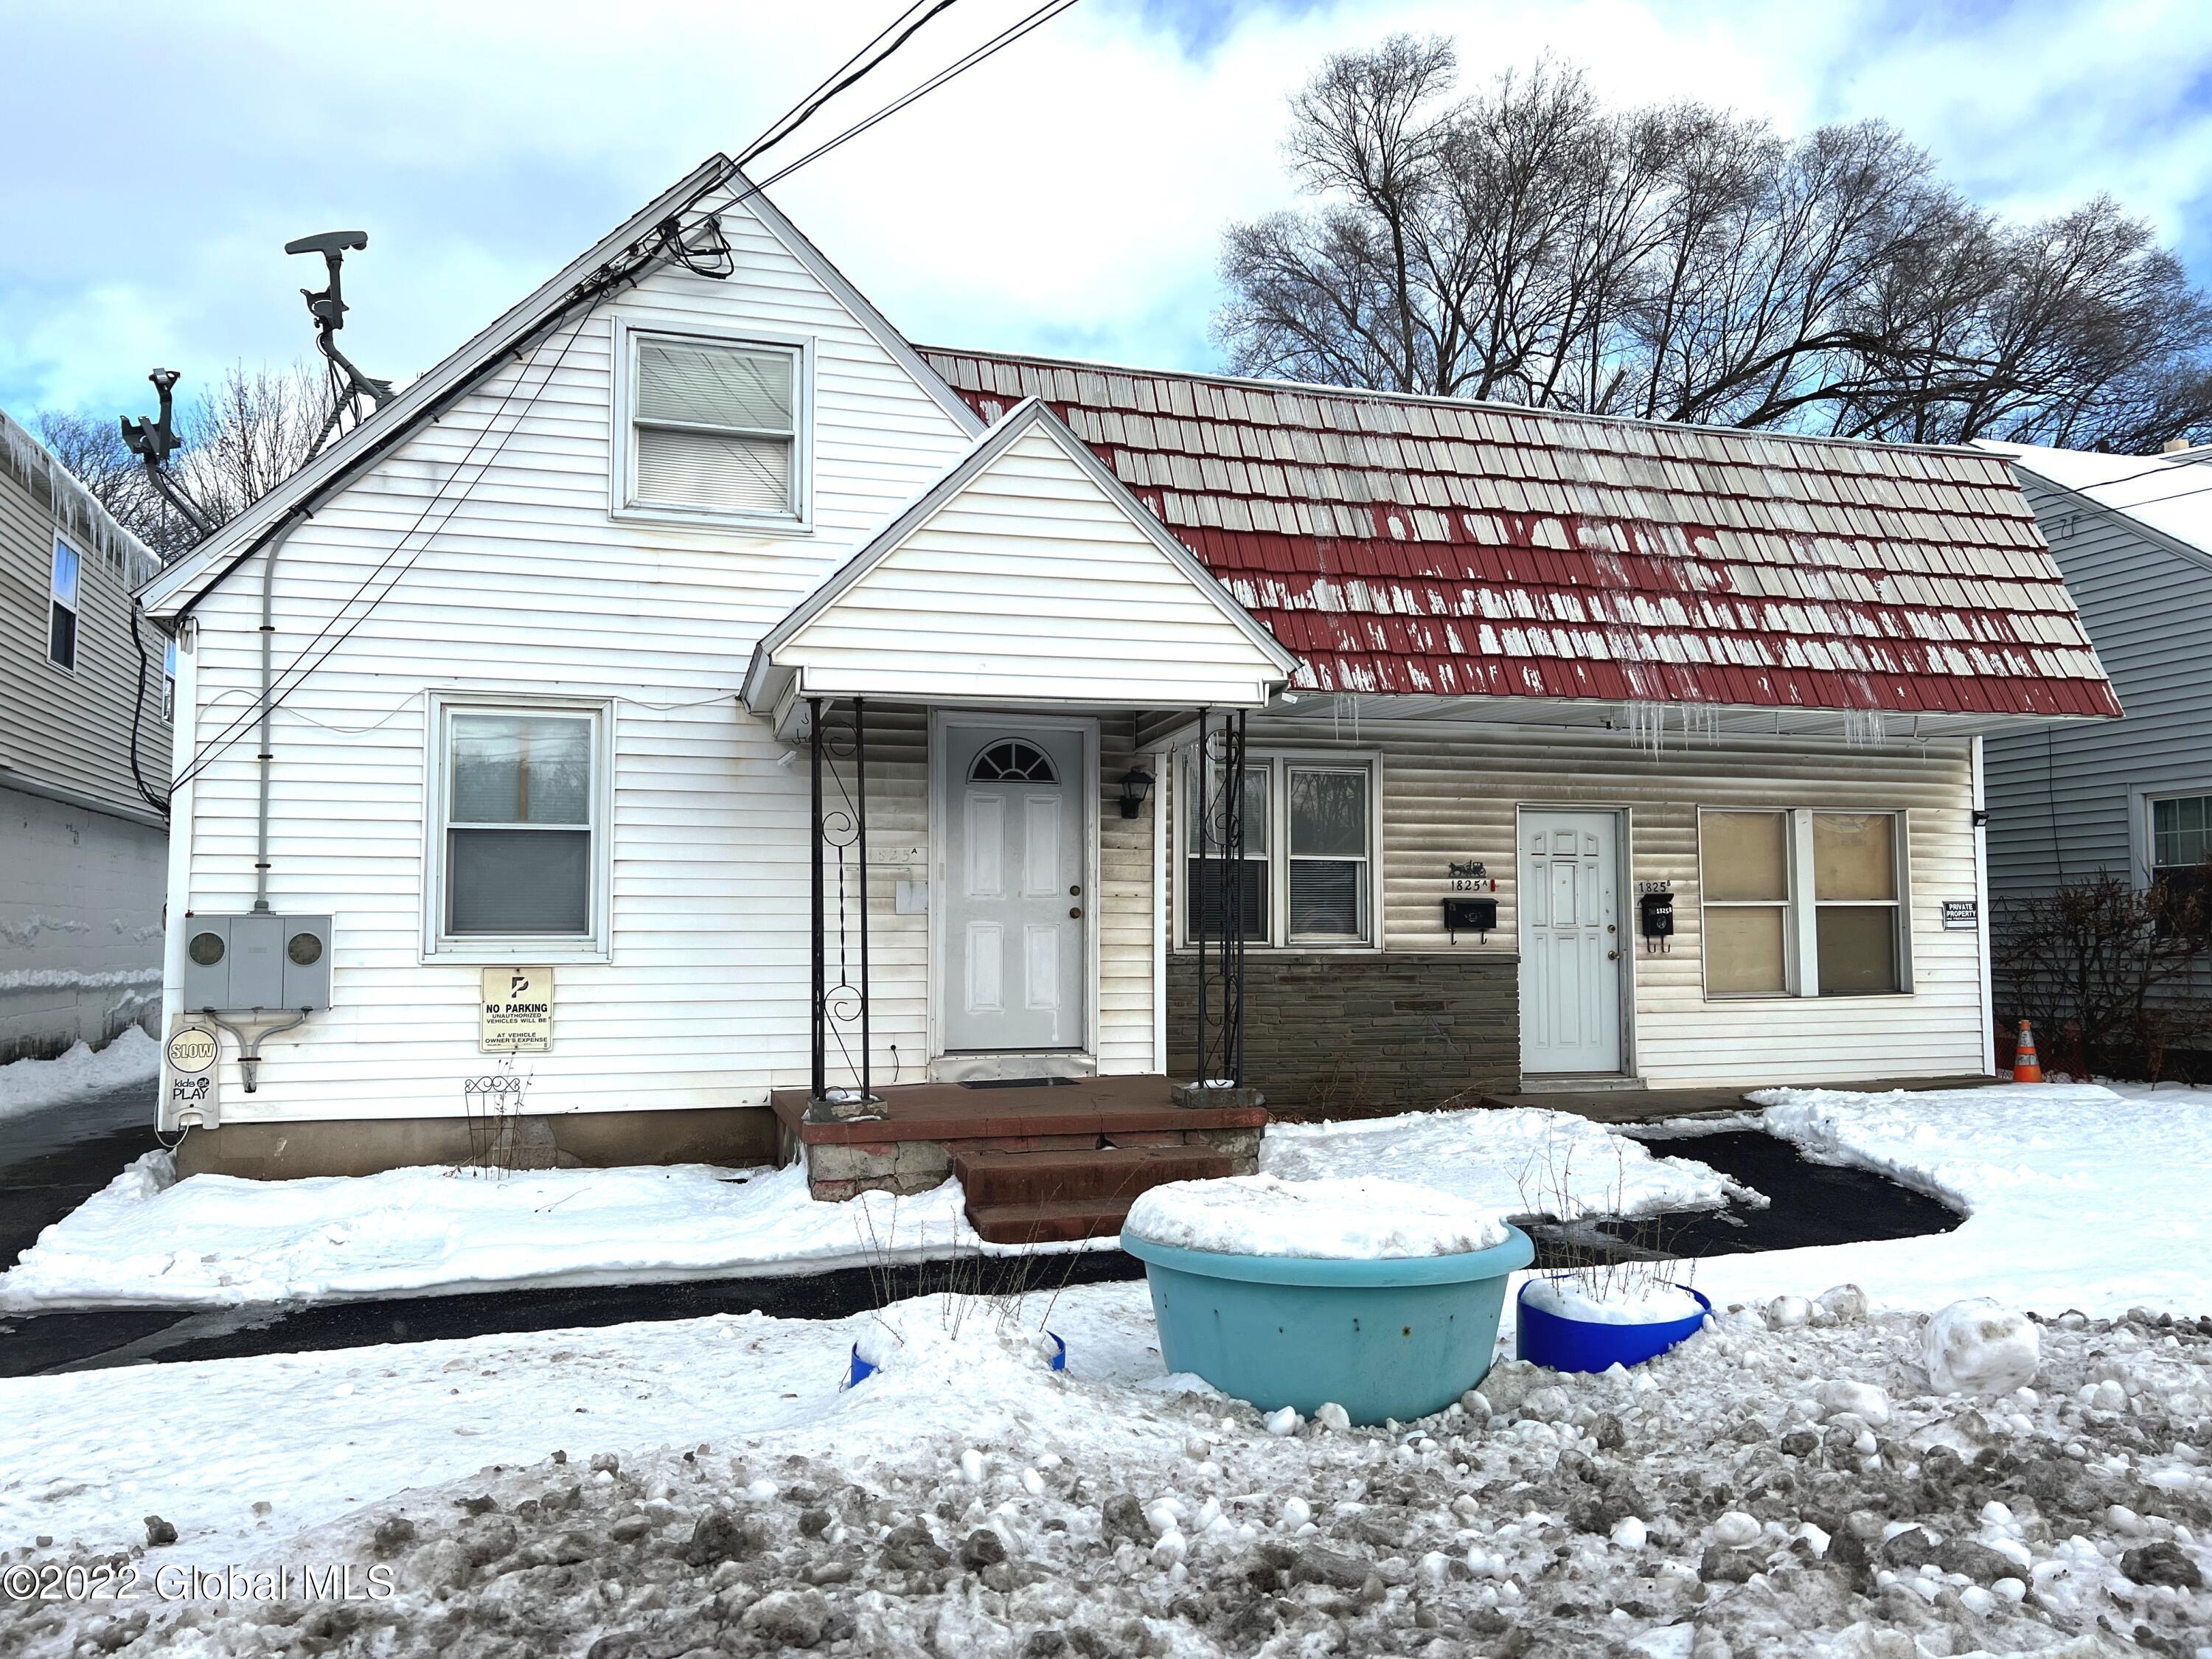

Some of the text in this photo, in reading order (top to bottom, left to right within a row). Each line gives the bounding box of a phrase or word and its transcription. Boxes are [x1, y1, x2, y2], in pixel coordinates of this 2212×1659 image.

[487, 1004, 548, 1013] NO PARKING
[171, 1043, 215, 1060] SLOW
[174, 1078, 209, 1088] kids at
[173, 1088, 209, 1101] PLAY
